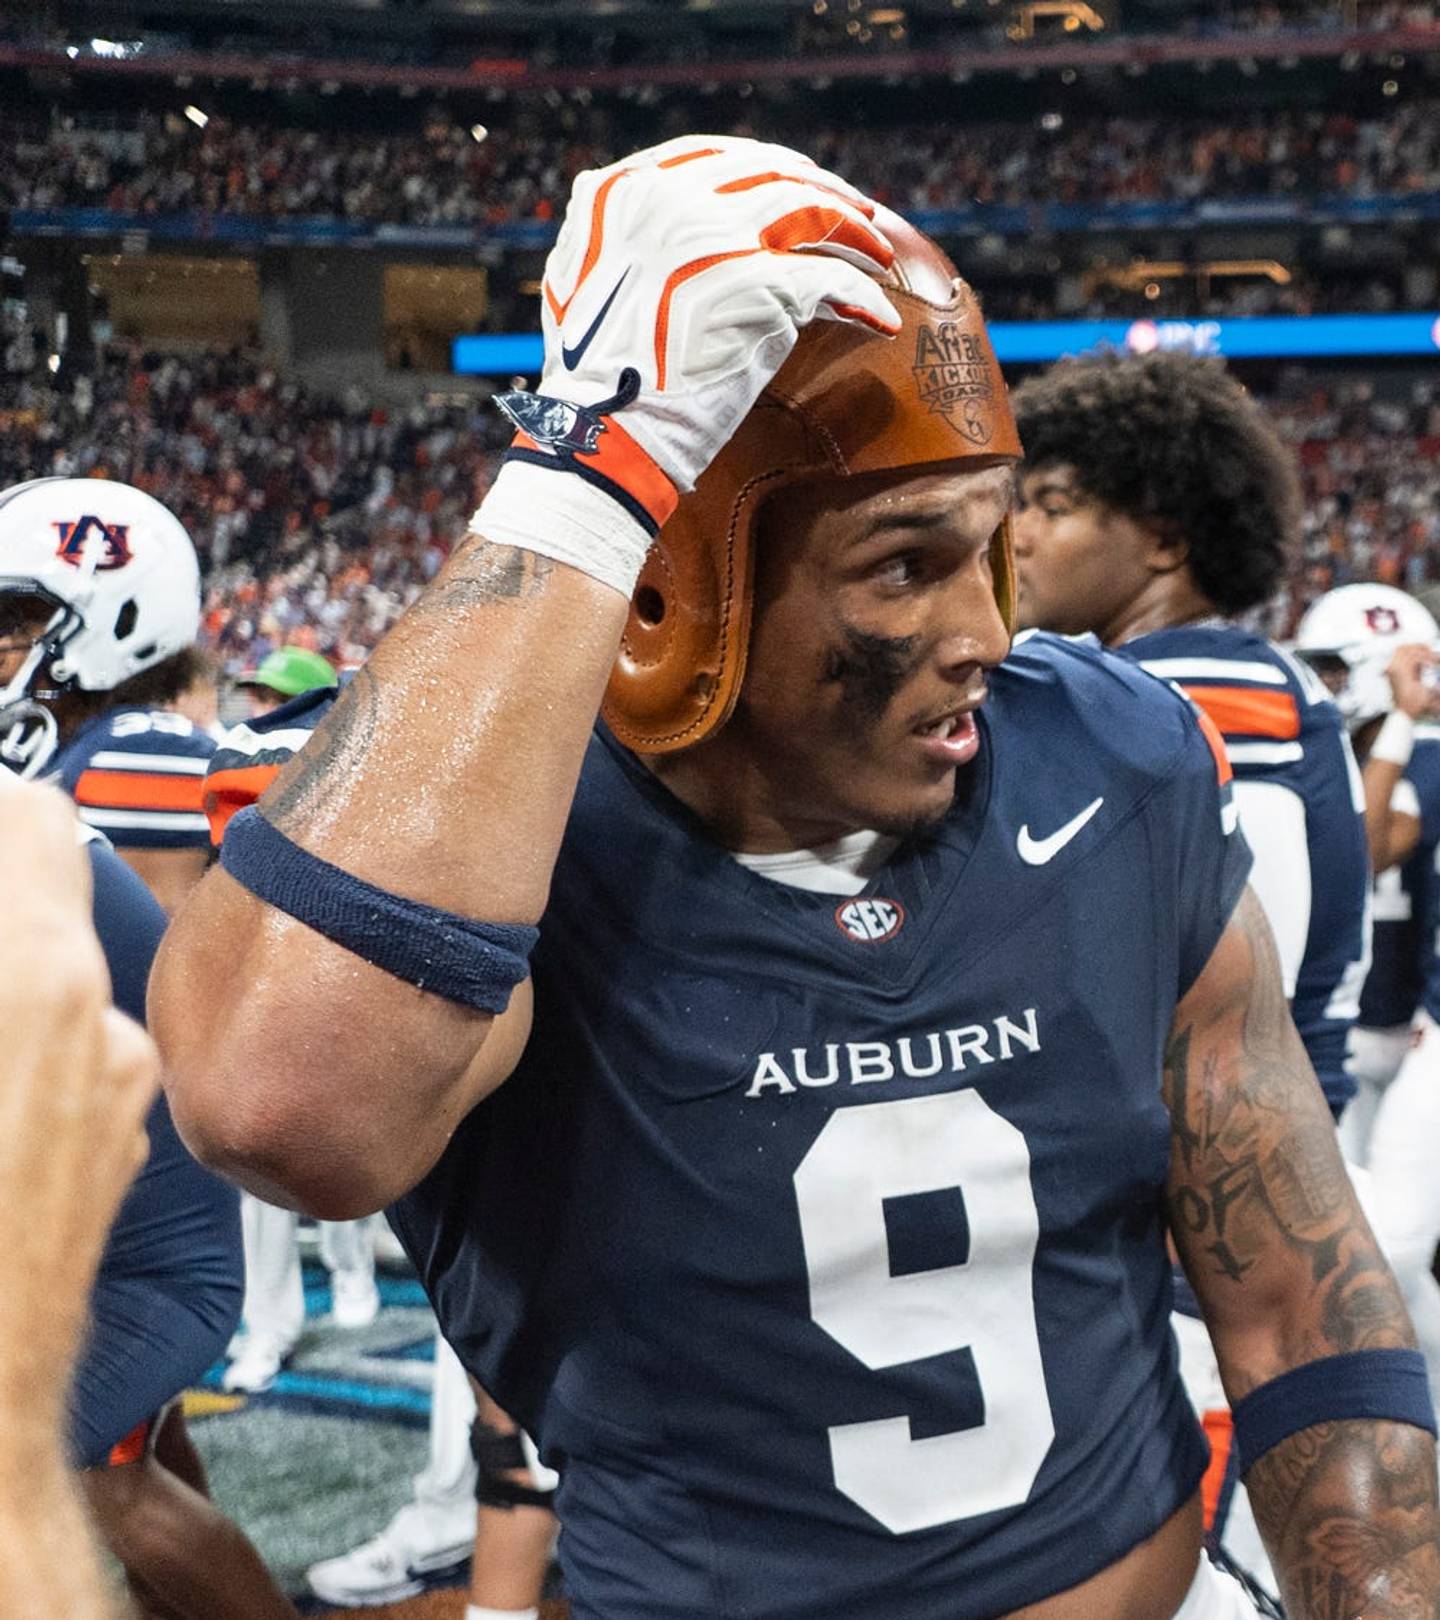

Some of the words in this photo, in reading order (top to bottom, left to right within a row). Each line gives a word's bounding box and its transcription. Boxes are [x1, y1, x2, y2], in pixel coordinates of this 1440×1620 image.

[841, 900, 898, 939] SEC
[745, 1008, 1041, 1097] AUBURN
[792, 1087, 1056, 1535] 9
